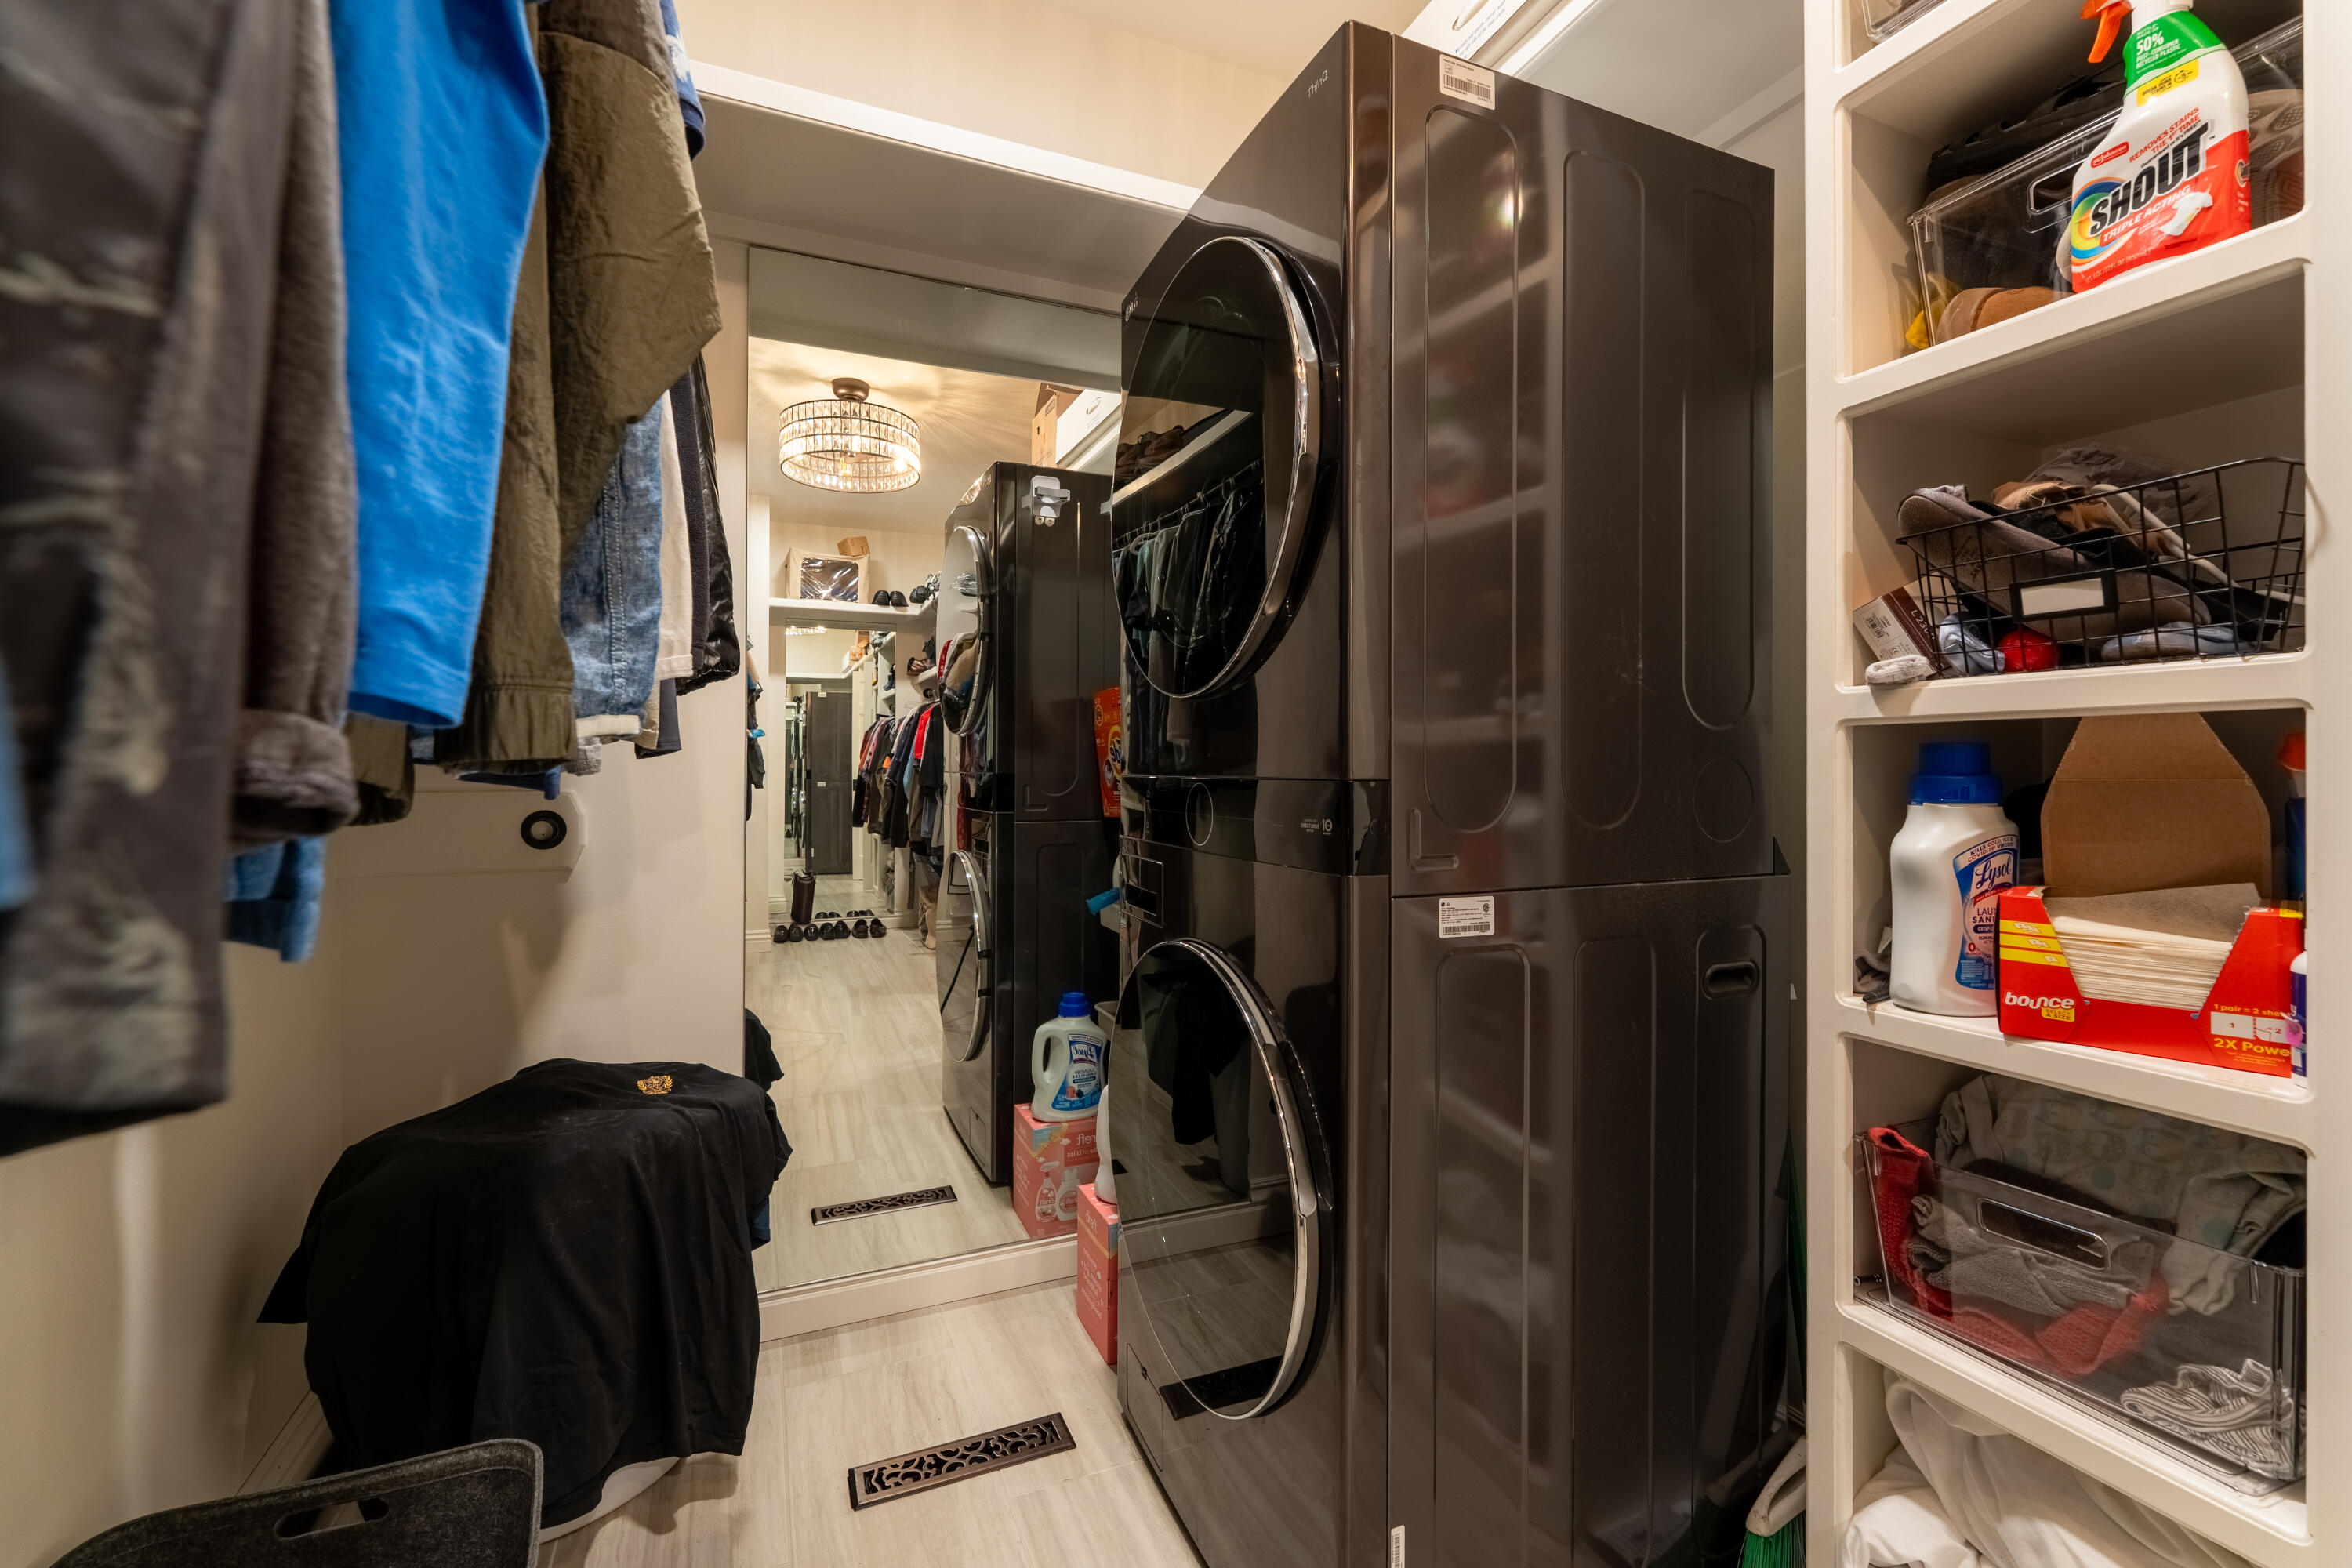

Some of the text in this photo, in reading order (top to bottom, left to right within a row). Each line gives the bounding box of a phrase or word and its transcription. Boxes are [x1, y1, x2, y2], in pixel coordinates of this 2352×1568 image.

[2136, 31, 2164, 56] 50%
[2160, 44, 2180, 57] PLASTIC
[2129, 107, 2199, 163] REMOVES STAINS
[2151, 141, 2167, 154] THE
[2178, 114, 2200, 133] TIME
[2089, 122, 2209, 235] SHOUT
[2103, 214, 2141, 242] TRIPLE
[2143, 185, 2191, 219] ACTING
[1323, 818, 1332, 832] 10
[1970, 844, 1986, 855] KILLS
[1975, 855, 2012, 889] Lysol
[2005, 991, 2074, 1010] bounce
[2220, 1004, 2242, 1014] pair
[2213, 1038, 2291, 1057] 2X Powe
